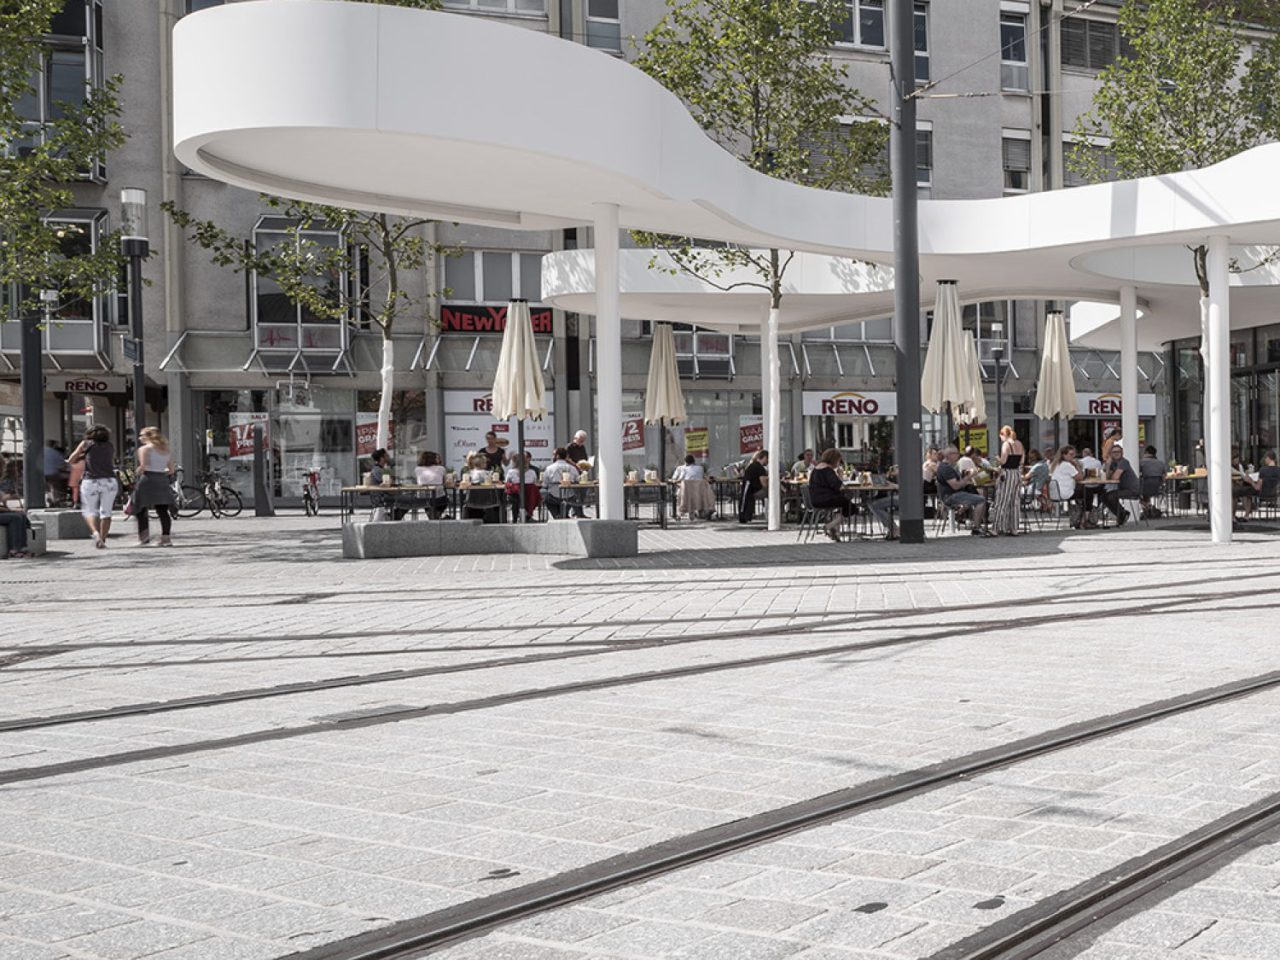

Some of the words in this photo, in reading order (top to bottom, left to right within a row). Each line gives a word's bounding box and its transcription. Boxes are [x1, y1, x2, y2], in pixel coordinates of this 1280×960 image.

[64, 381, 108, 392] RENO
[473, 398, 493, 412] RE
[821, 399, 879, 415] RENO
[1088, 400, 1123, 414] REN
[742, 434, 763, 443] GRAT
